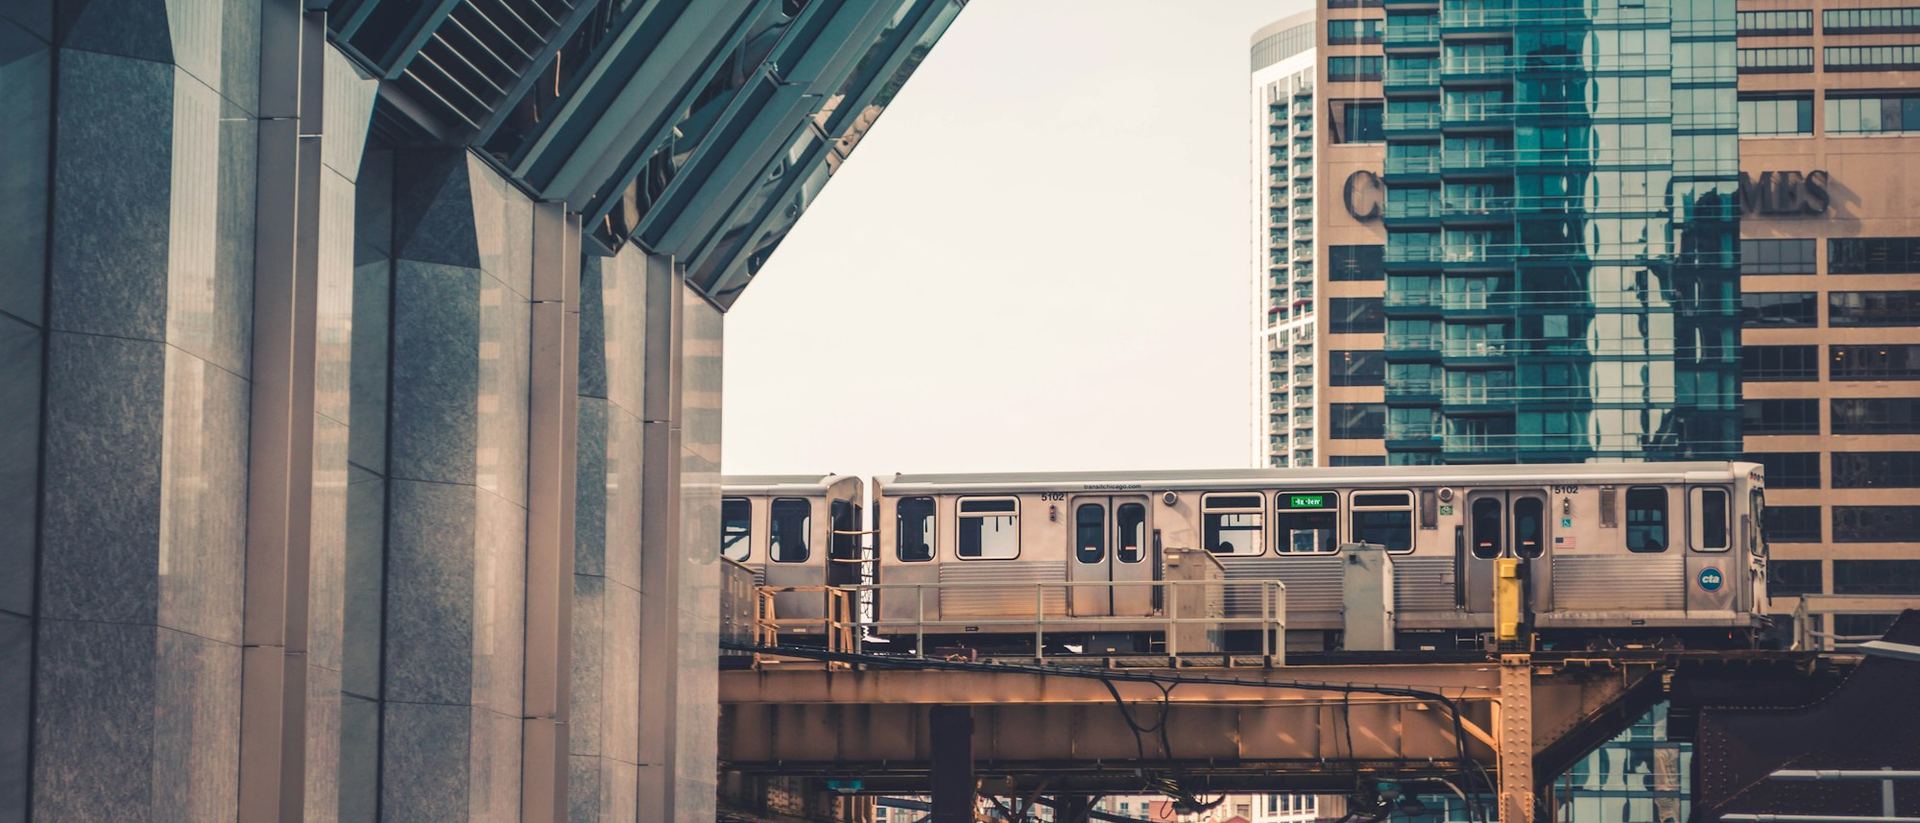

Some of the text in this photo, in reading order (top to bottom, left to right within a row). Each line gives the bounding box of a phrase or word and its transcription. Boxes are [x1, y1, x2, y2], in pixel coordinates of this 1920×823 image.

[1083, 484, 1142, 492] transitchicago.com
[1555, 484, 1578, 494] 5102
[1041, 491, 1064, 501] 5102
[1701, 575, 1720, 583] cta
